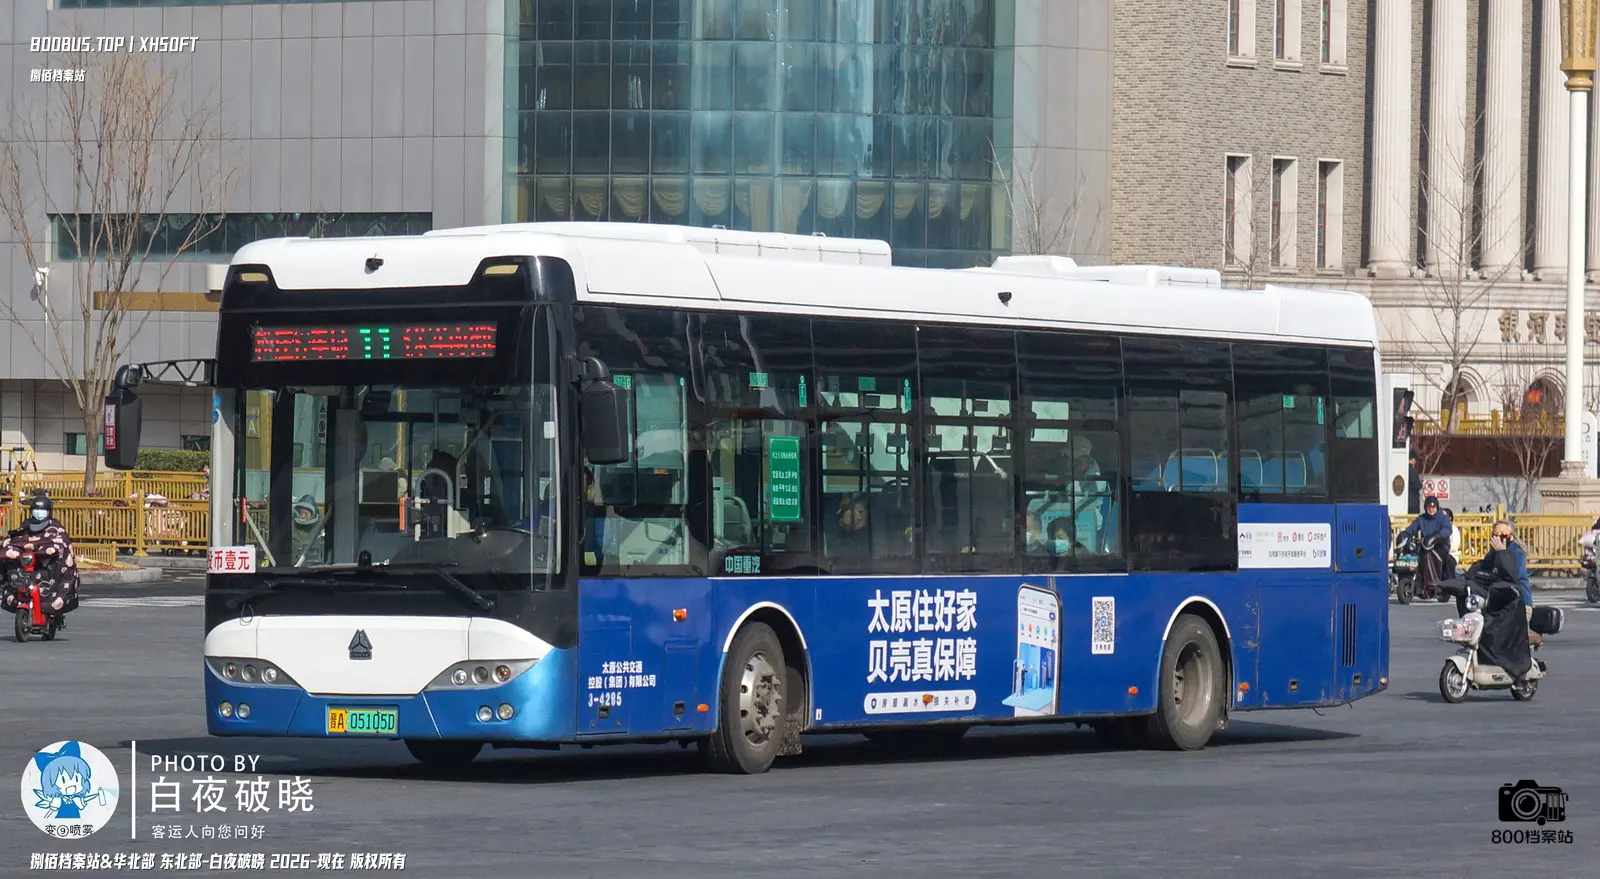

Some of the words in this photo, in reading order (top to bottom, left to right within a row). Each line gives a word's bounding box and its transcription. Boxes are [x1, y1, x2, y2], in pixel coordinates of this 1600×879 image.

[725, 555, 761, 574] 中国重汽
[867, 588, 978, 633] 太原住好家
[602, 661, 643, 674] 太原公共交通
[866, 637, 977, 683] 贝壳真保障
[588, 691, 622, 708] 3-4285
